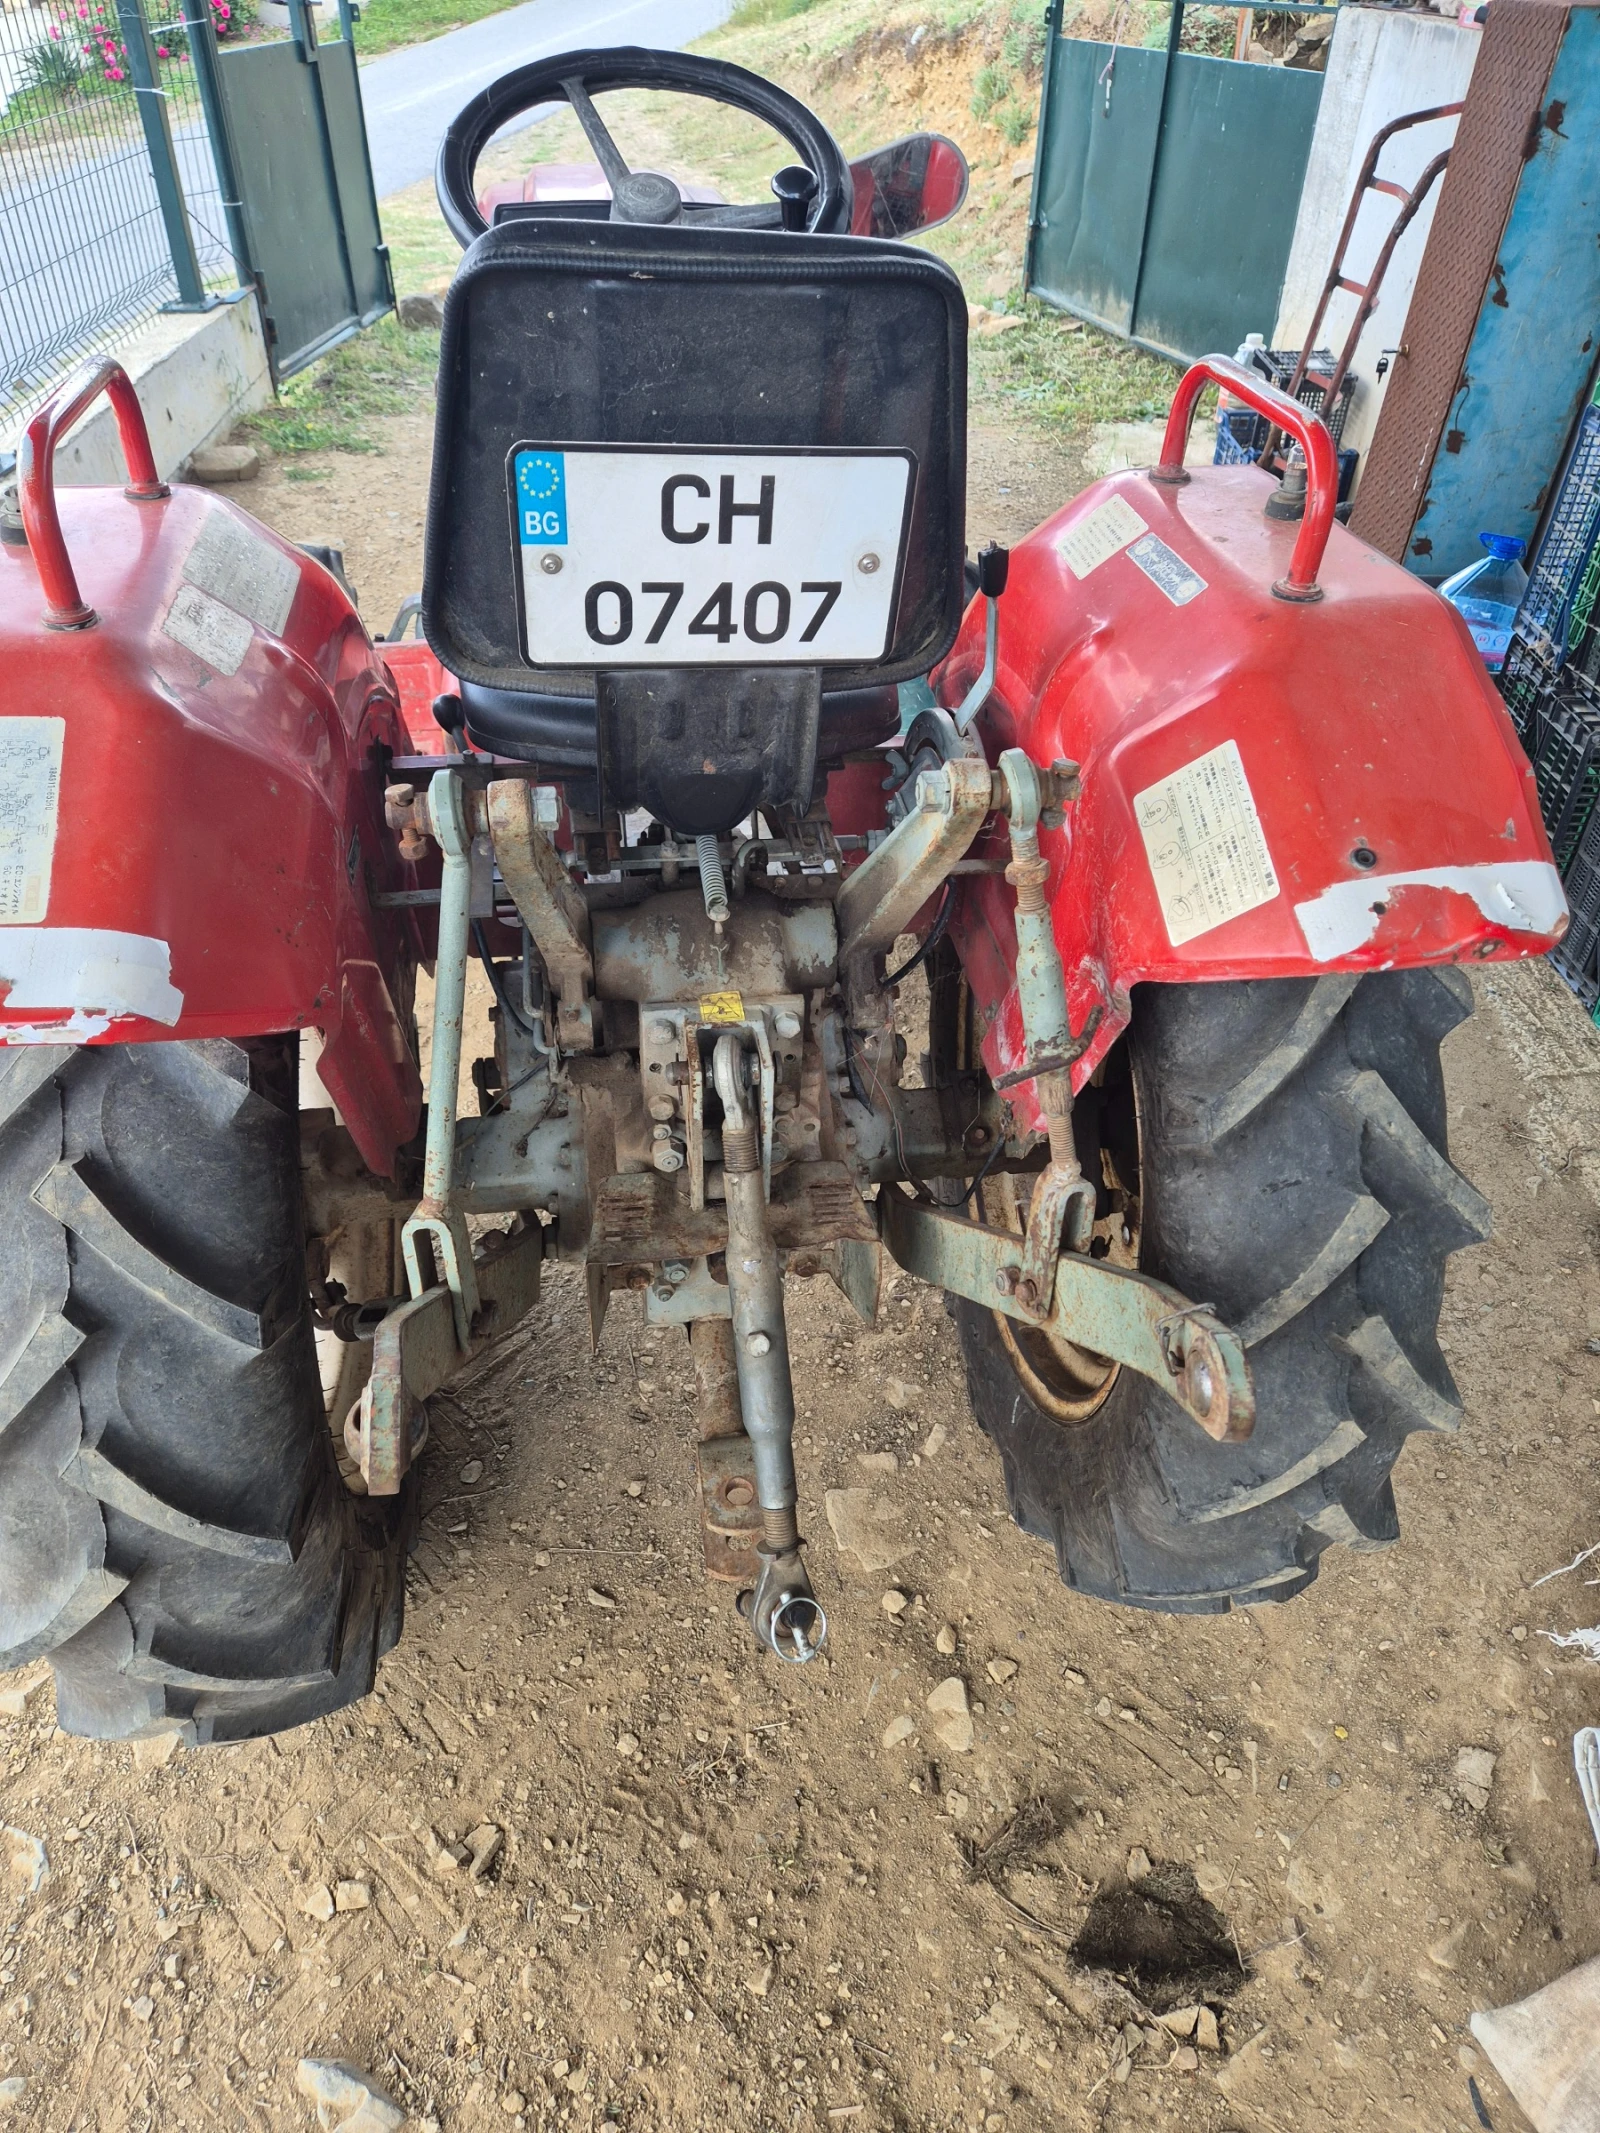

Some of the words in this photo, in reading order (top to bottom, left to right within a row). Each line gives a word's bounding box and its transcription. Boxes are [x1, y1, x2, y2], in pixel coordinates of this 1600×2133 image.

[524, 511, 560, 536] BG
[660, 474, 776, 545] CH
[584, 580, 843, 646] 07407
